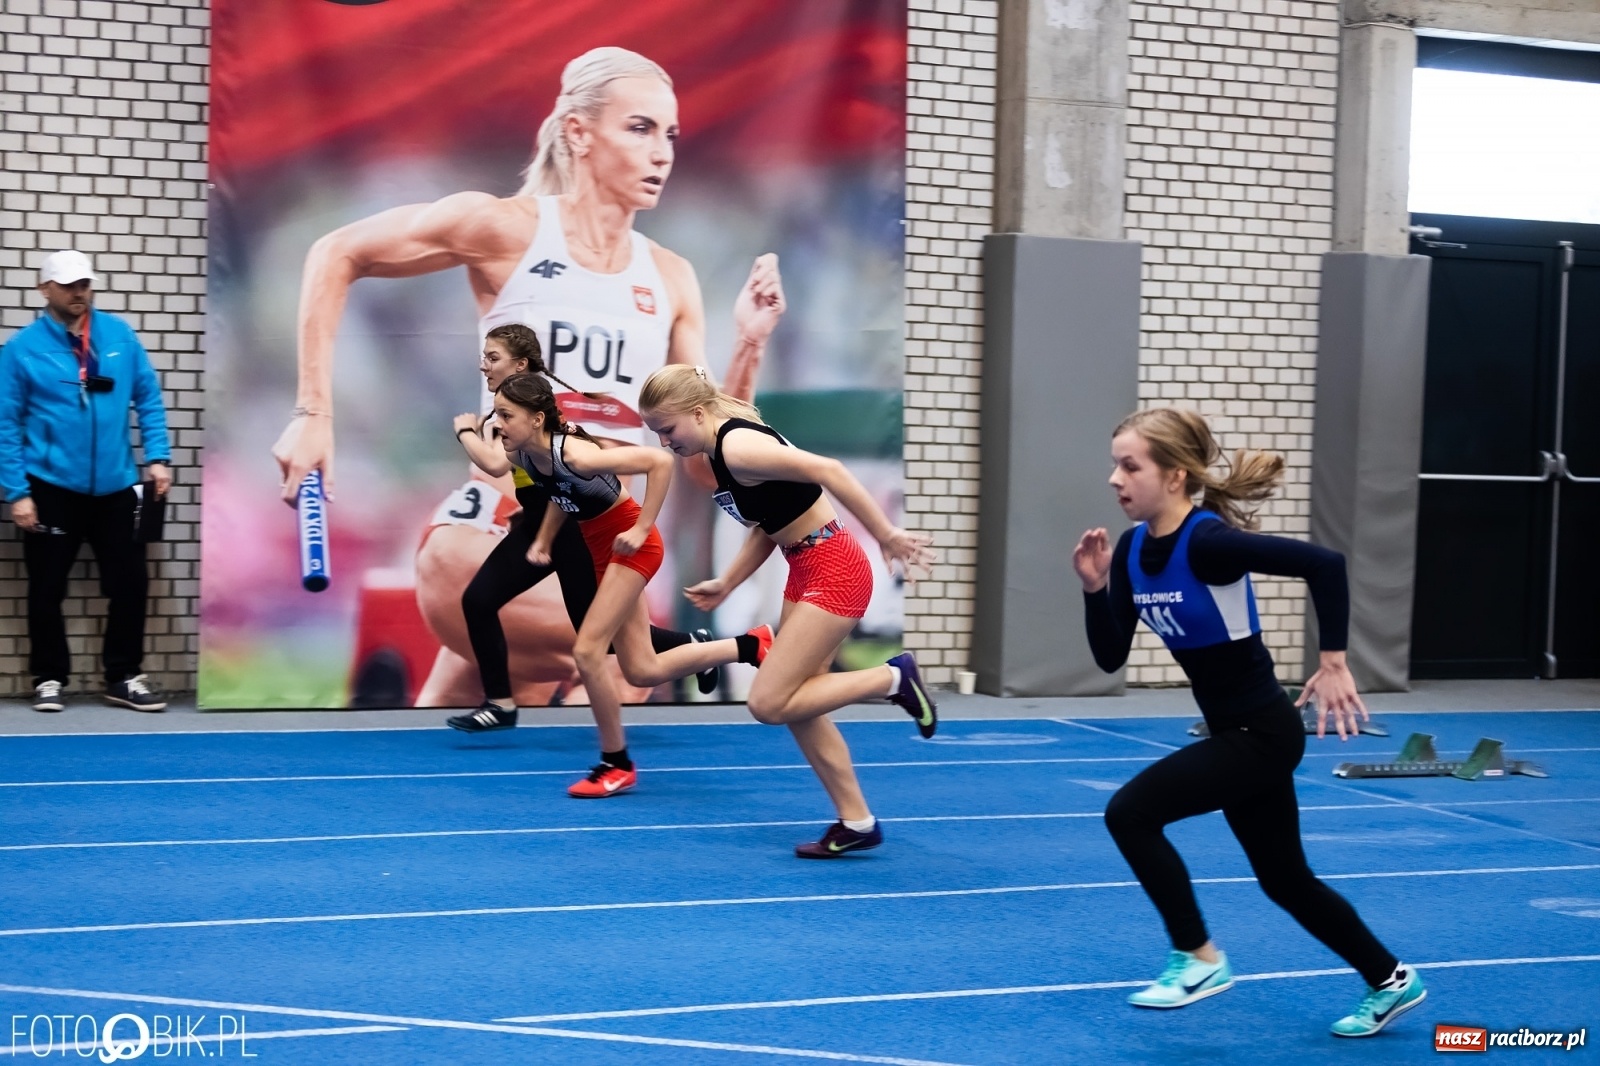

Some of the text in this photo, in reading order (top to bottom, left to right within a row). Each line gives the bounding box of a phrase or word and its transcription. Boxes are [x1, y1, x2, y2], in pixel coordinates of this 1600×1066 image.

[529, 259, 567, 279] 4F
[549, 320, 632, 384] POL
[449, 488, 482, 519] 3
